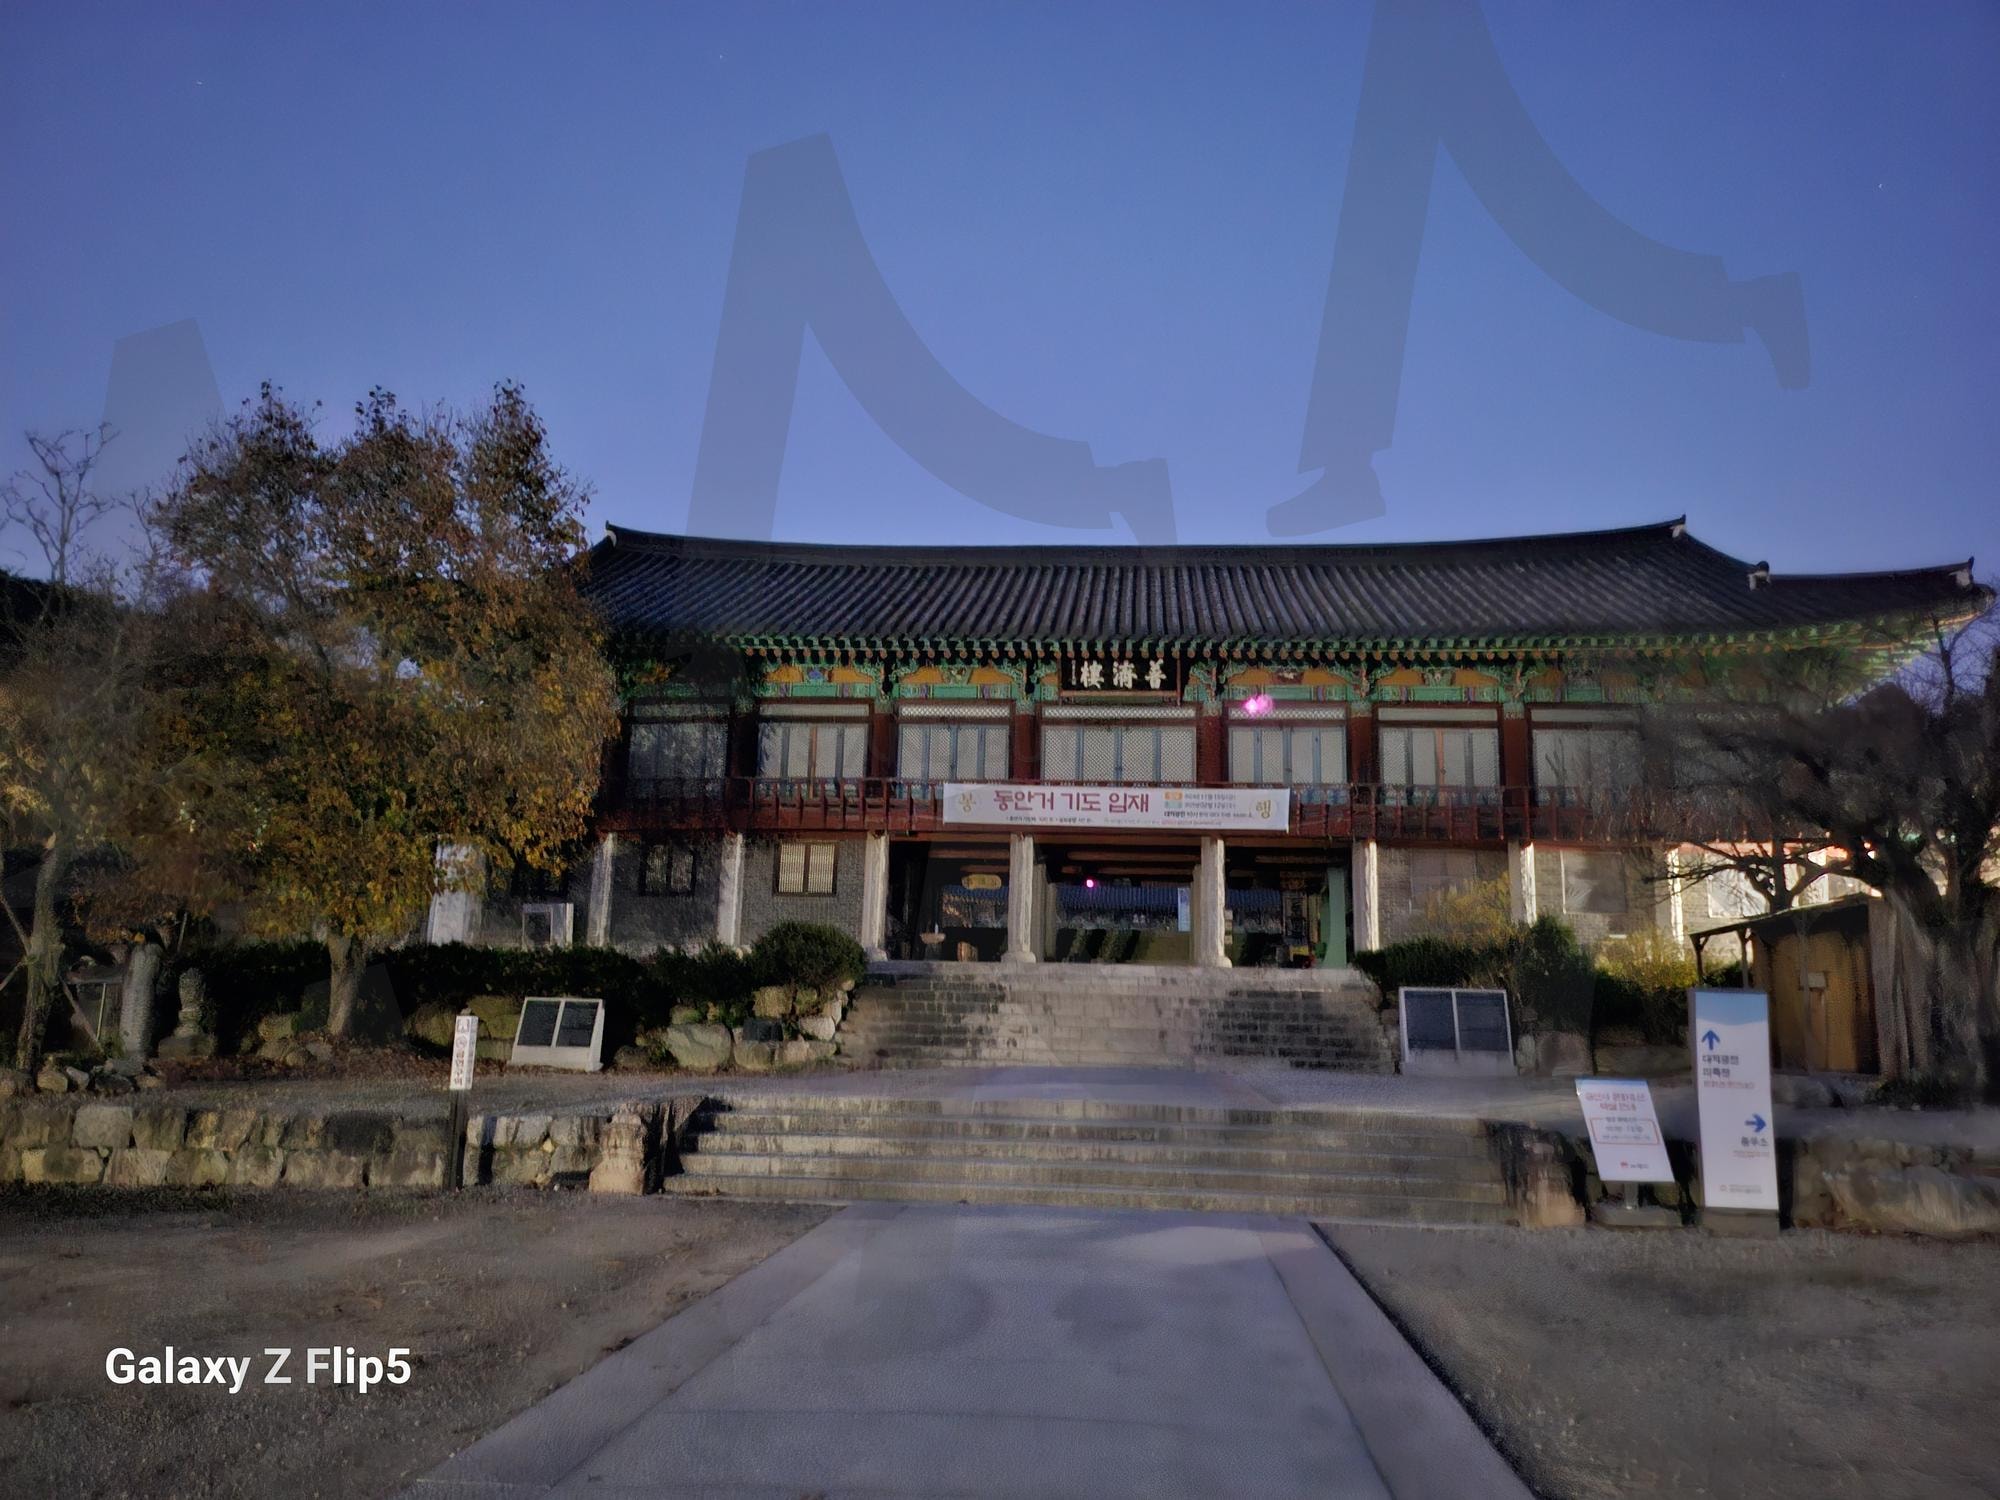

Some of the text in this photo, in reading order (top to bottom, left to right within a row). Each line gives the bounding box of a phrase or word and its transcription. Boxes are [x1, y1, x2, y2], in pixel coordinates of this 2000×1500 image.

[993, 790, 1149, 813] 동안거 기도 입재
